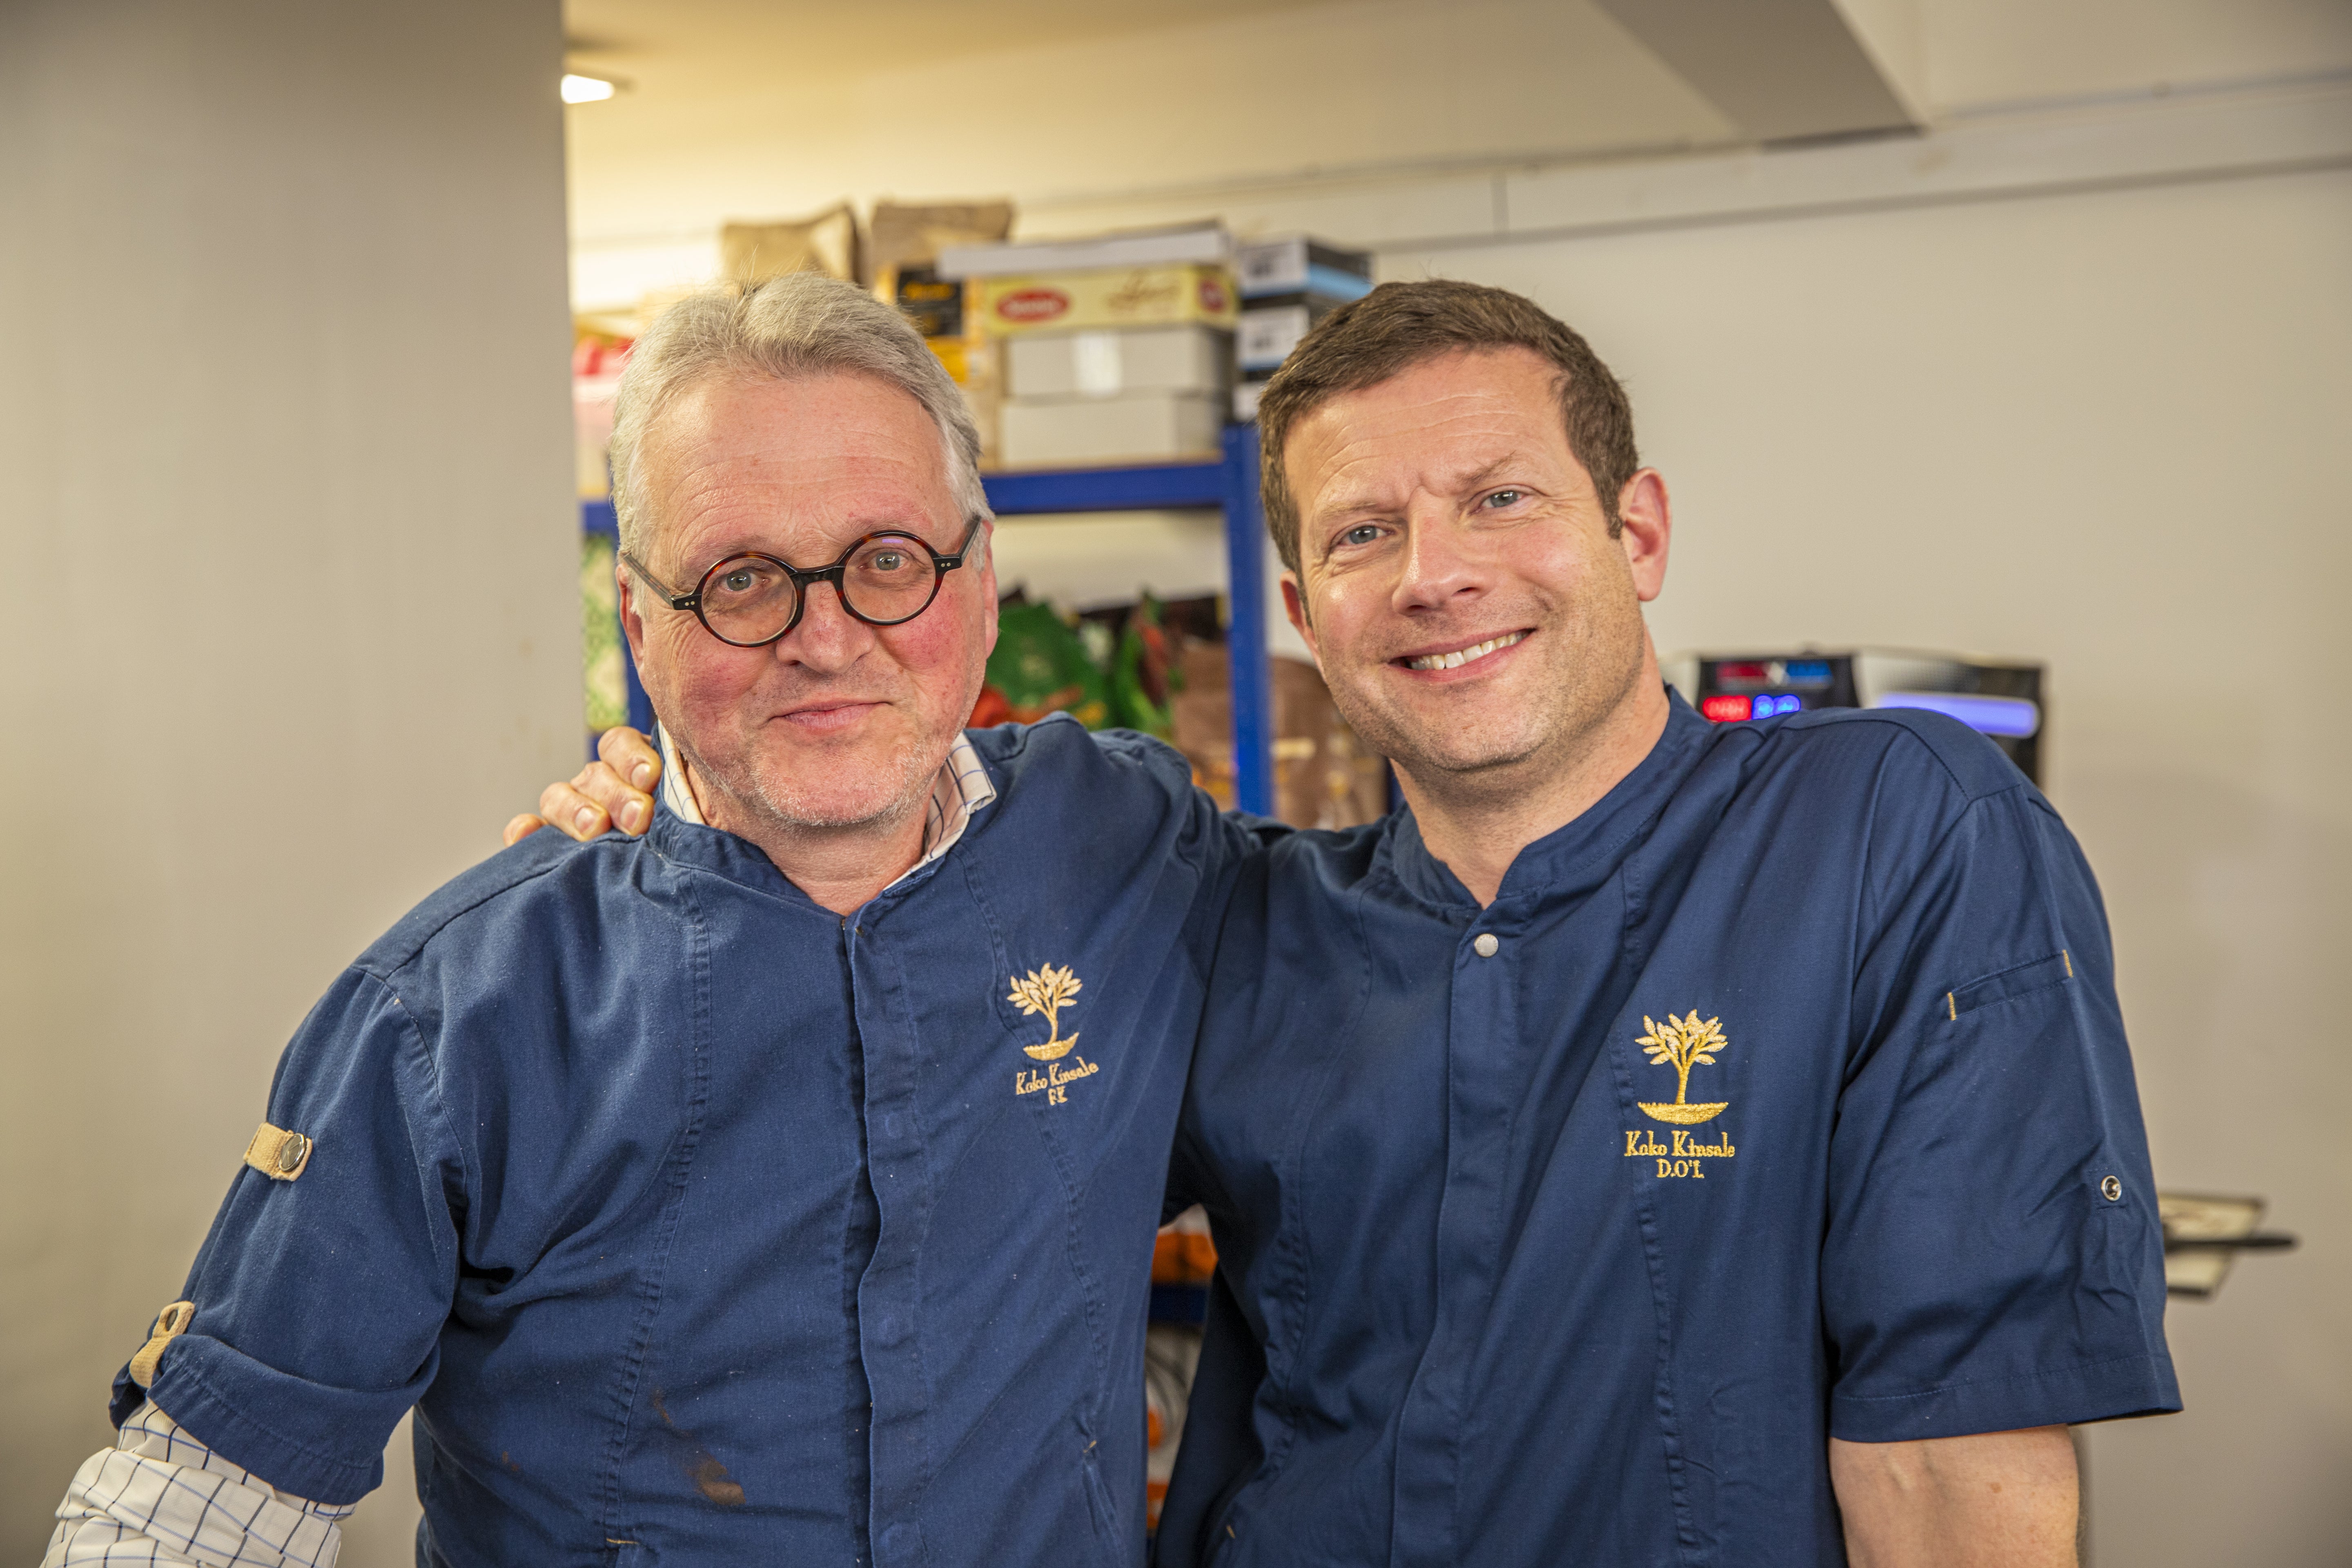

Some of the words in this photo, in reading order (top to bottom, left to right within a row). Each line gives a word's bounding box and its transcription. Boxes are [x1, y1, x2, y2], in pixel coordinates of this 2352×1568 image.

[1016, 1069, 1048, 1095] Koko
[1049, 1056, 1099, 1086] Kinsale
[1624, 1130, 1668, 1157] Koko
[1671, 1130, 1735, 1158] Kinsale
